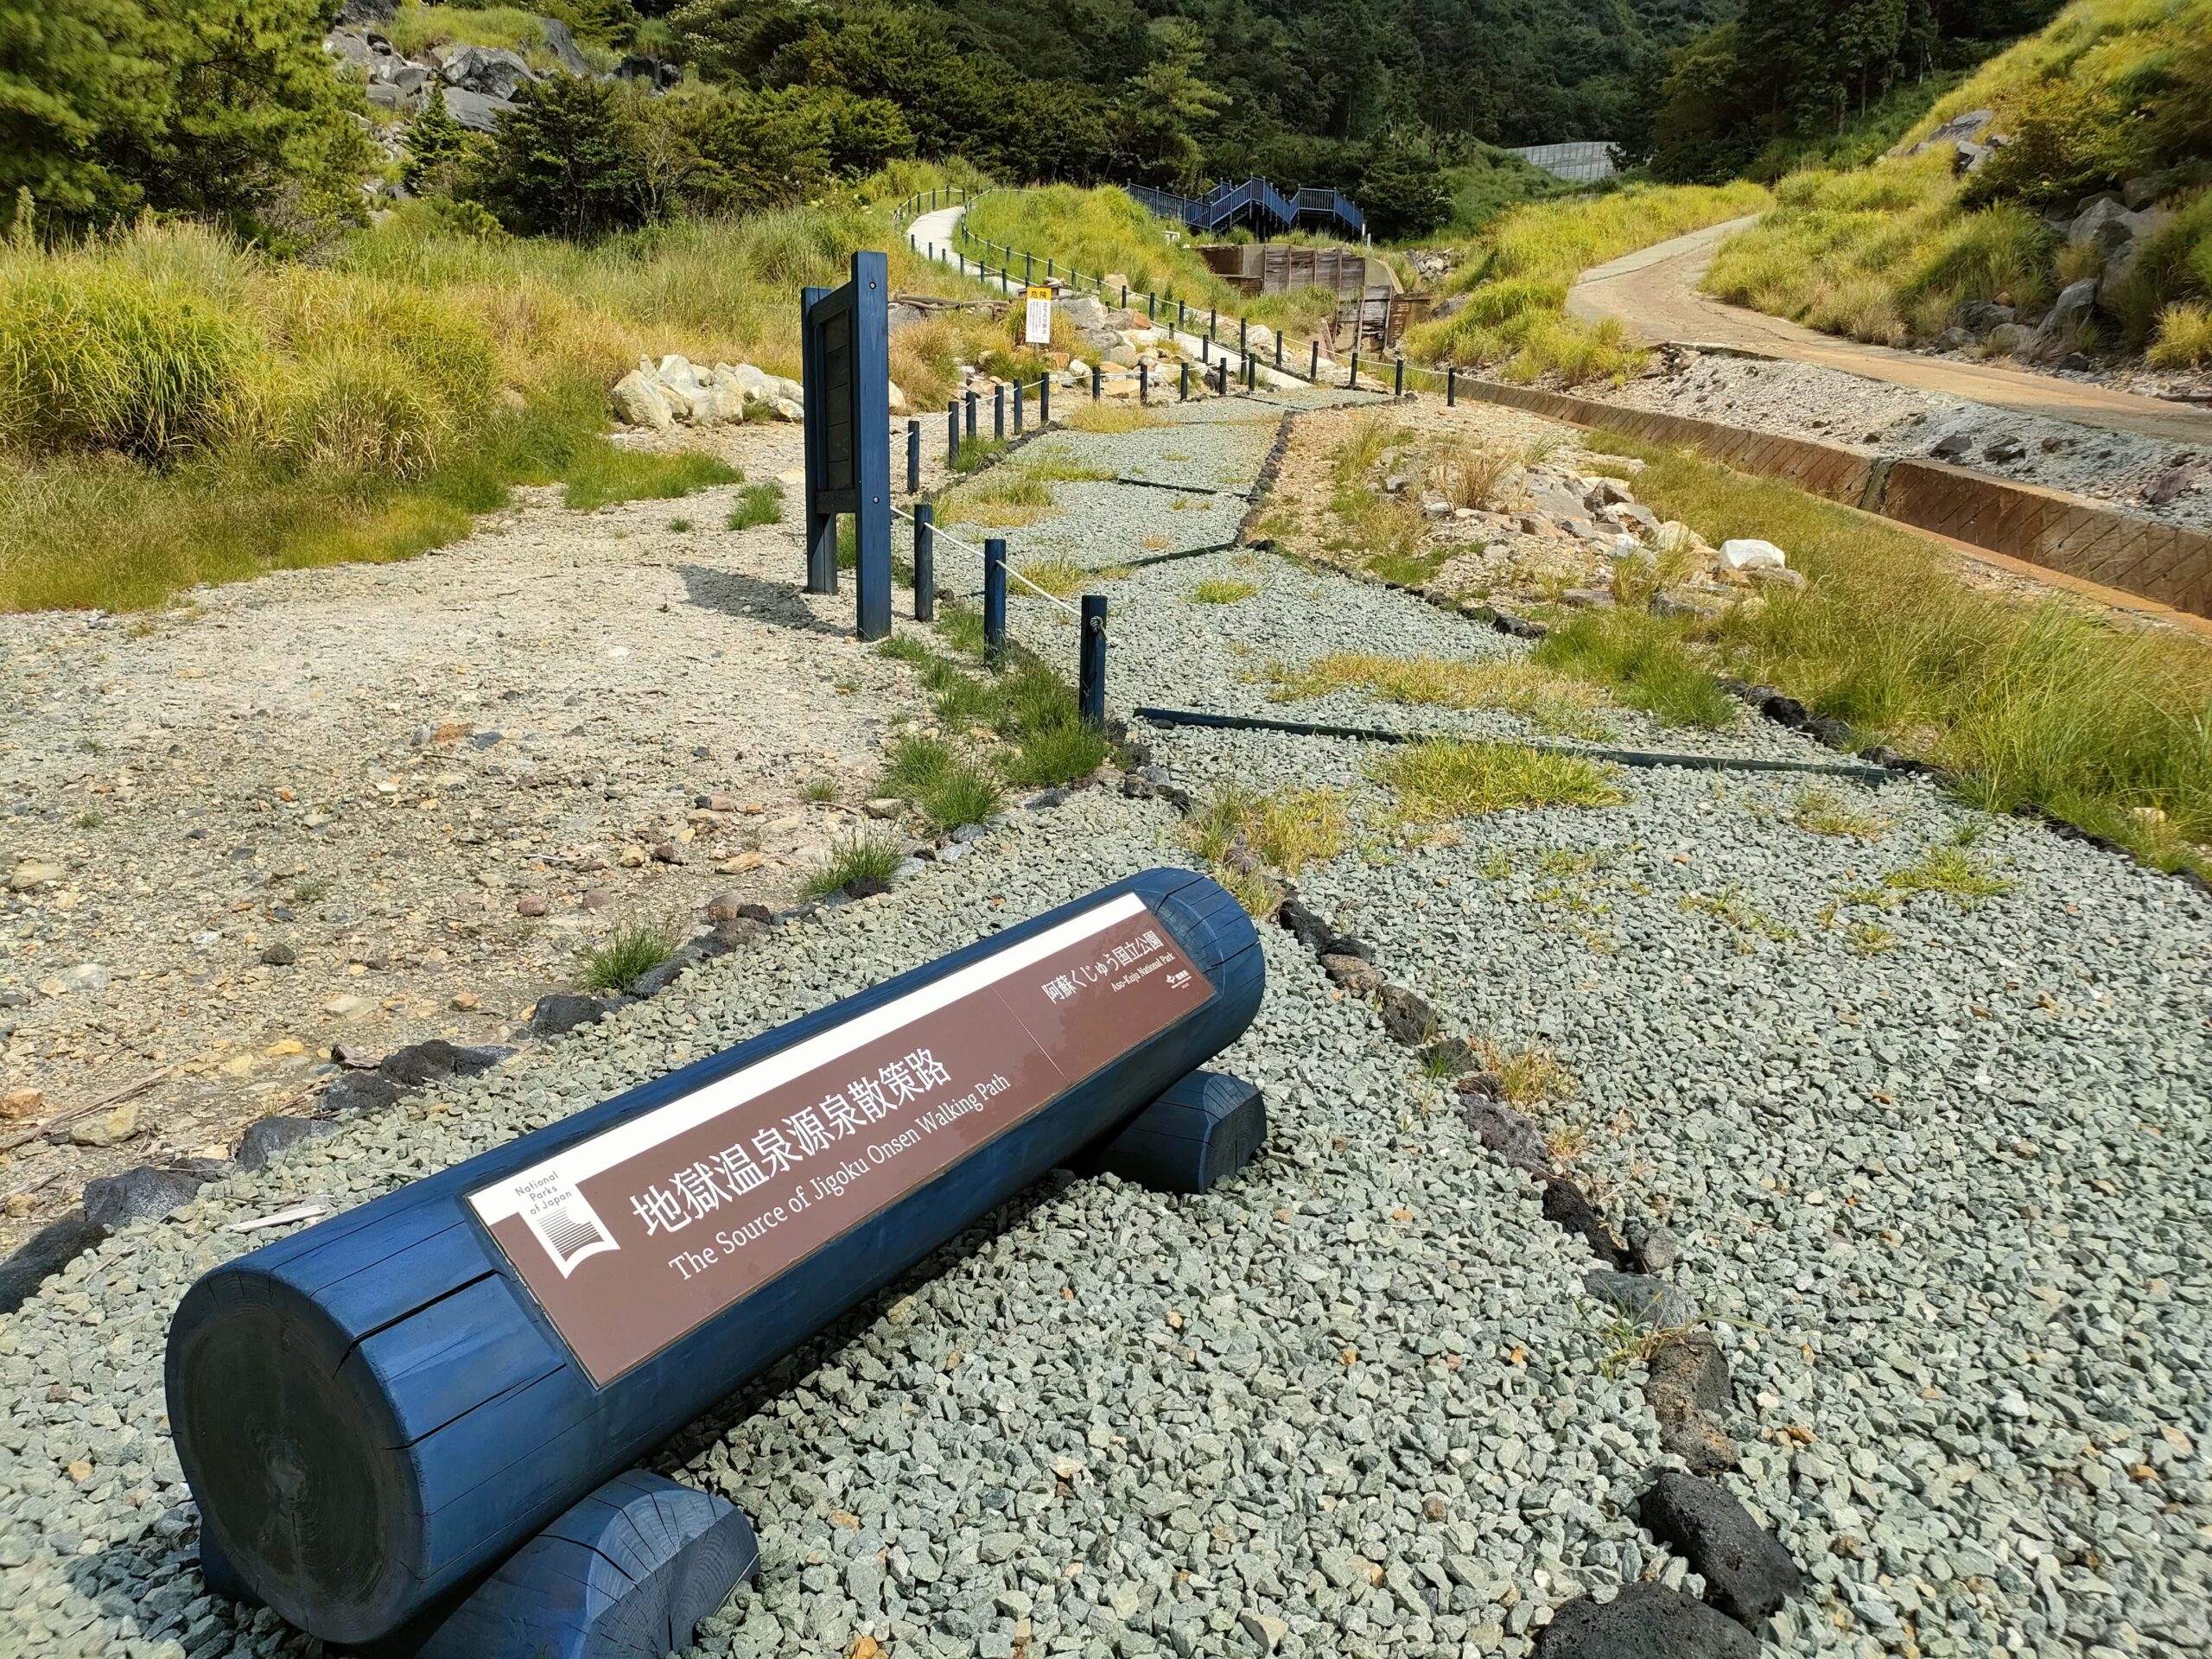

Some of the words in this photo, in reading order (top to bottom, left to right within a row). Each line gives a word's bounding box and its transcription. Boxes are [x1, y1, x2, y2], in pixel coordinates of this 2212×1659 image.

[1041, 930, 1164, 1004] 阿蘇くじゅう国立公園
[1111, 972, 1141, 992] Aso-Kuju
[1136, 957, 1163, 977] National
[1159, 951, 1175, 964] Park
[629, 1048, 951, 1236] 地獄温泉源泉散策路
[514, 1170, 559, 1196] National
[529, 1185, 558, 1201] Parks
[668, 1245, 719, 1280] The
[715, 1206, 788, 1255] Source
[788, 1186, 811, 1212] of
[809, 1158, 870, 1200] Jigoku
[867, 1127, 921, 1164] Onsen
[914, 1093, 984, 1134] Walking
[974, 1073, 1012, 1102] Path
[530, 1203, 541, 1215] of
[542, 1191, 572, 1210] Japan
